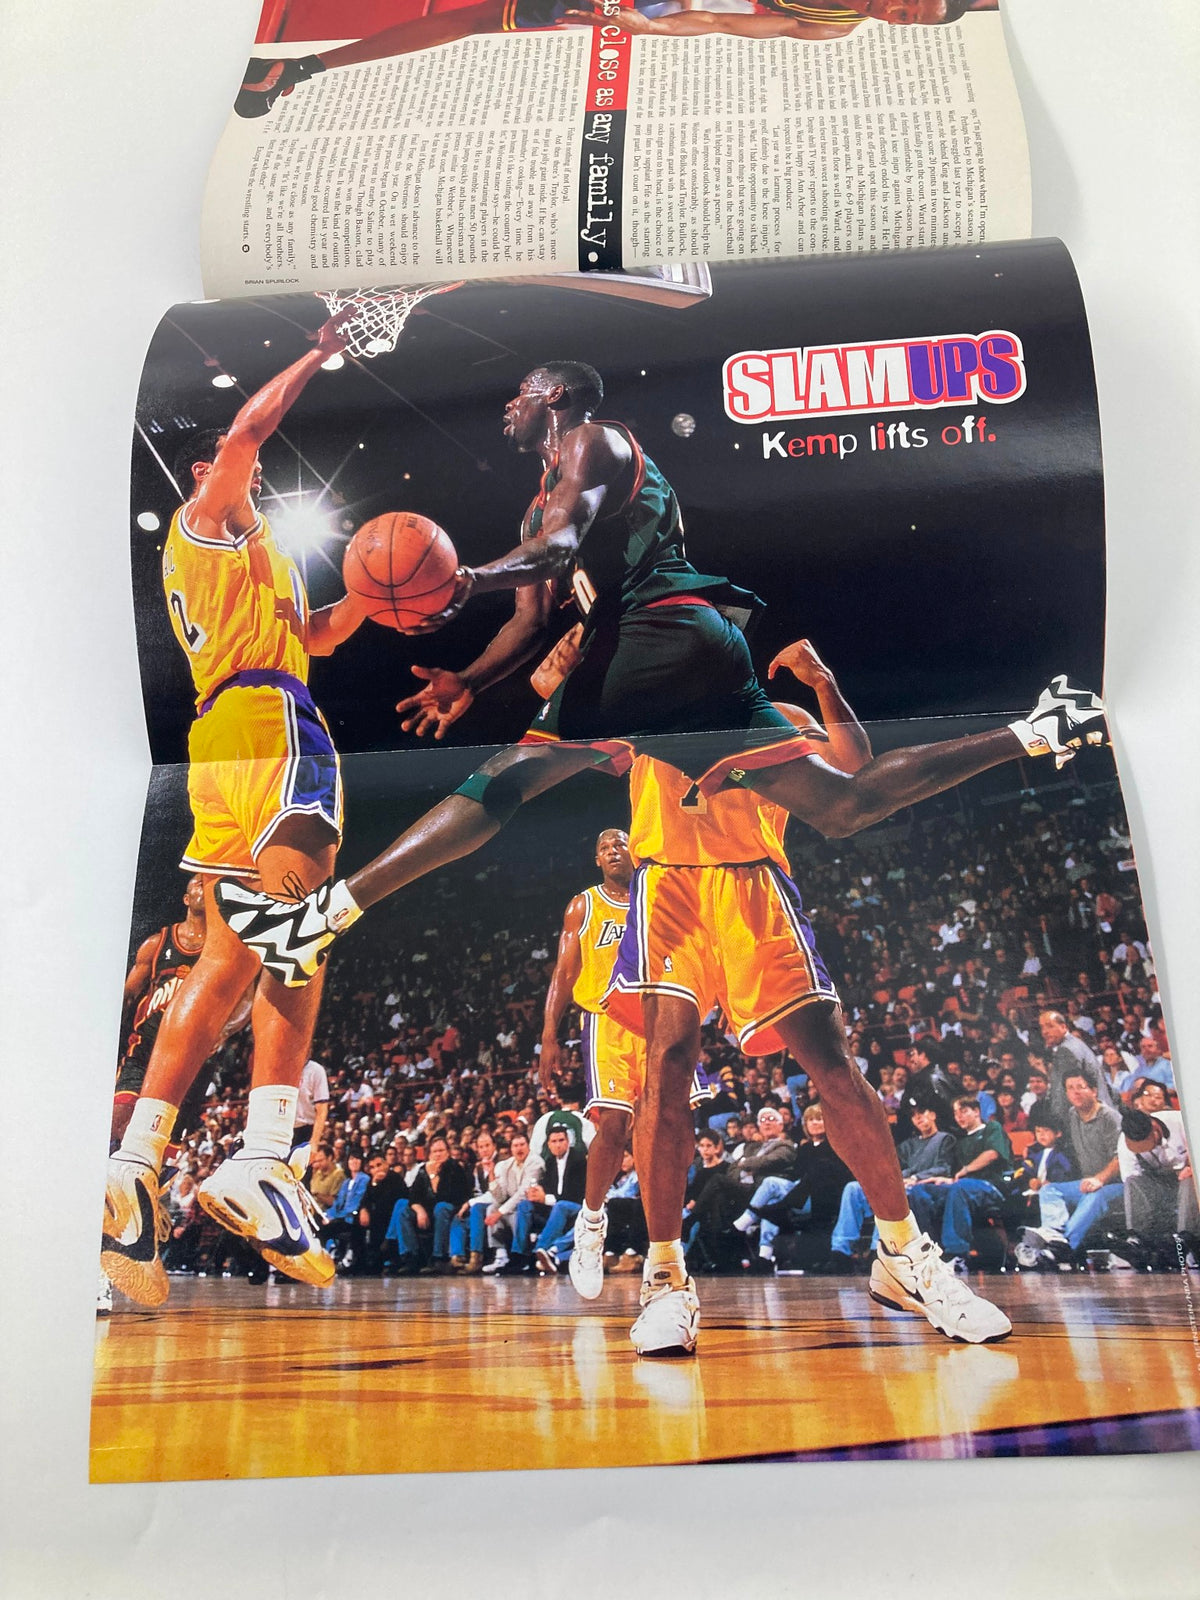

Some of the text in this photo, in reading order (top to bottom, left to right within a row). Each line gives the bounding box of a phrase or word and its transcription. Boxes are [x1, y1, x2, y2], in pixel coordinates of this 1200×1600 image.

[597, 25, 627, 81] close
[595, 88, 614, 107] as
[585, 113, 614, 144] any
[940, 162, 949, 178] King
[391, 191, 399, 201] On
[435, 176, 445, 206] Michigan
[749, 172, 757, 211] opportunity
[773, 176, 781, 203] learning
[809, 181, 817, 205] reports
[893, 180, 901, 205] against
[243, 188, 254, 218] wrestling
[310, 195, 320, 211] good
[355, 191, 365, 216] Though
[580, 153, 615, 263] family.
[821, 189, 829, 221] shooting
[857, 180, 865, 240] Michigan plans
[309, 214, 318, 250] chemistry
[470, 222, 476, 232] 50
[480, 209, 488, 236] players
[503, 214, 511, 242] country
[539, 216, 546, 225] he
[702, 223, 710, 240] help
[737, 219, 745, 241] going
[845, 208, 853, 237] players
[333, 231, 340, 240] of
[846, 240, 851, 251] on
[332, 242, 340, 267] outing
[366, 249, 374, 266] play
[468, 234, 476, 263] pounds
[493, 252, 500, 262] be
[516, 252, 523, 261] he
[538, 244, 546, 261] stay
[656, 248, 663, 257] of
[668, 246, 674, 256] he
[739, 244, 744, 254] on
[379, 257, 386, 266] of
[762, 415, 997, 459] Kemp lifts off.
